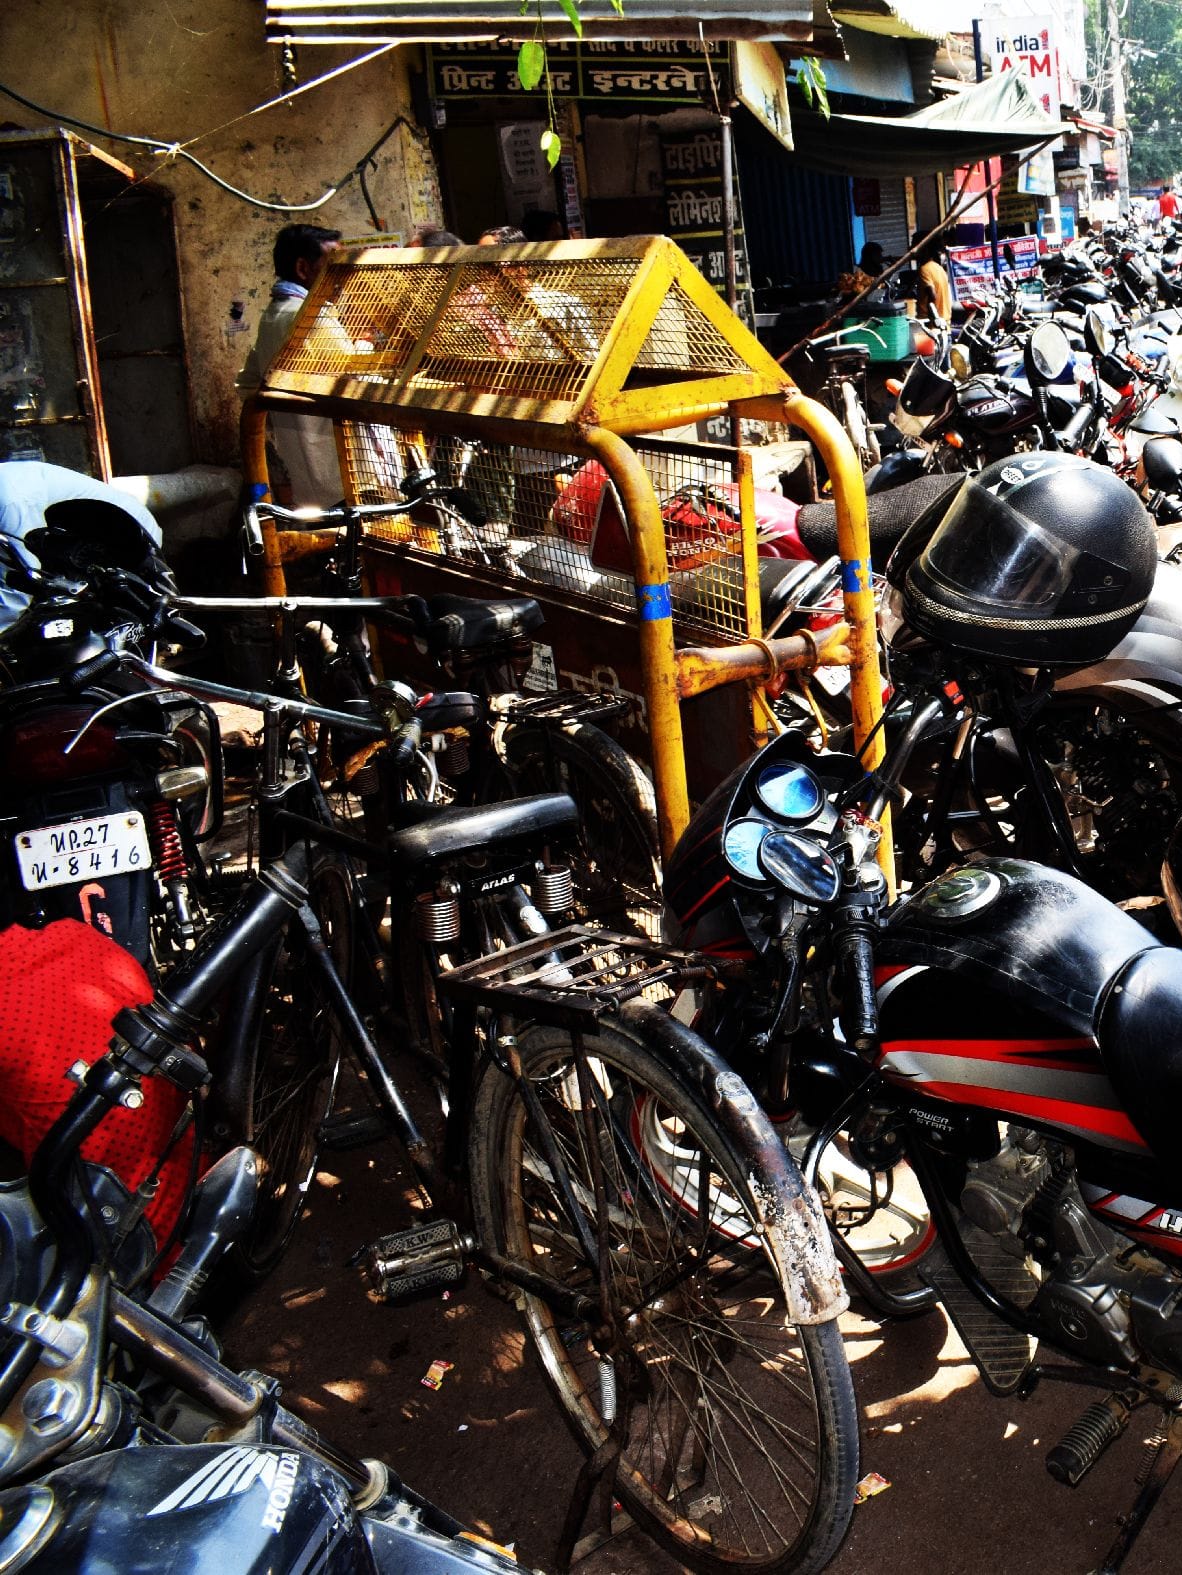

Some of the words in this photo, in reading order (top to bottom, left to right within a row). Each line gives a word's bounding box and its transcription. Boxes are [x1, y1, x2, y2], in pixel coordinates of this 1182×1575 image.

[481, 874, 515, 891] ATLAS
[909, 1108, 949, 1125] POWER
[917, 1117, 954, 1131] START
[261, 1452, 300, 1534] HONDA
